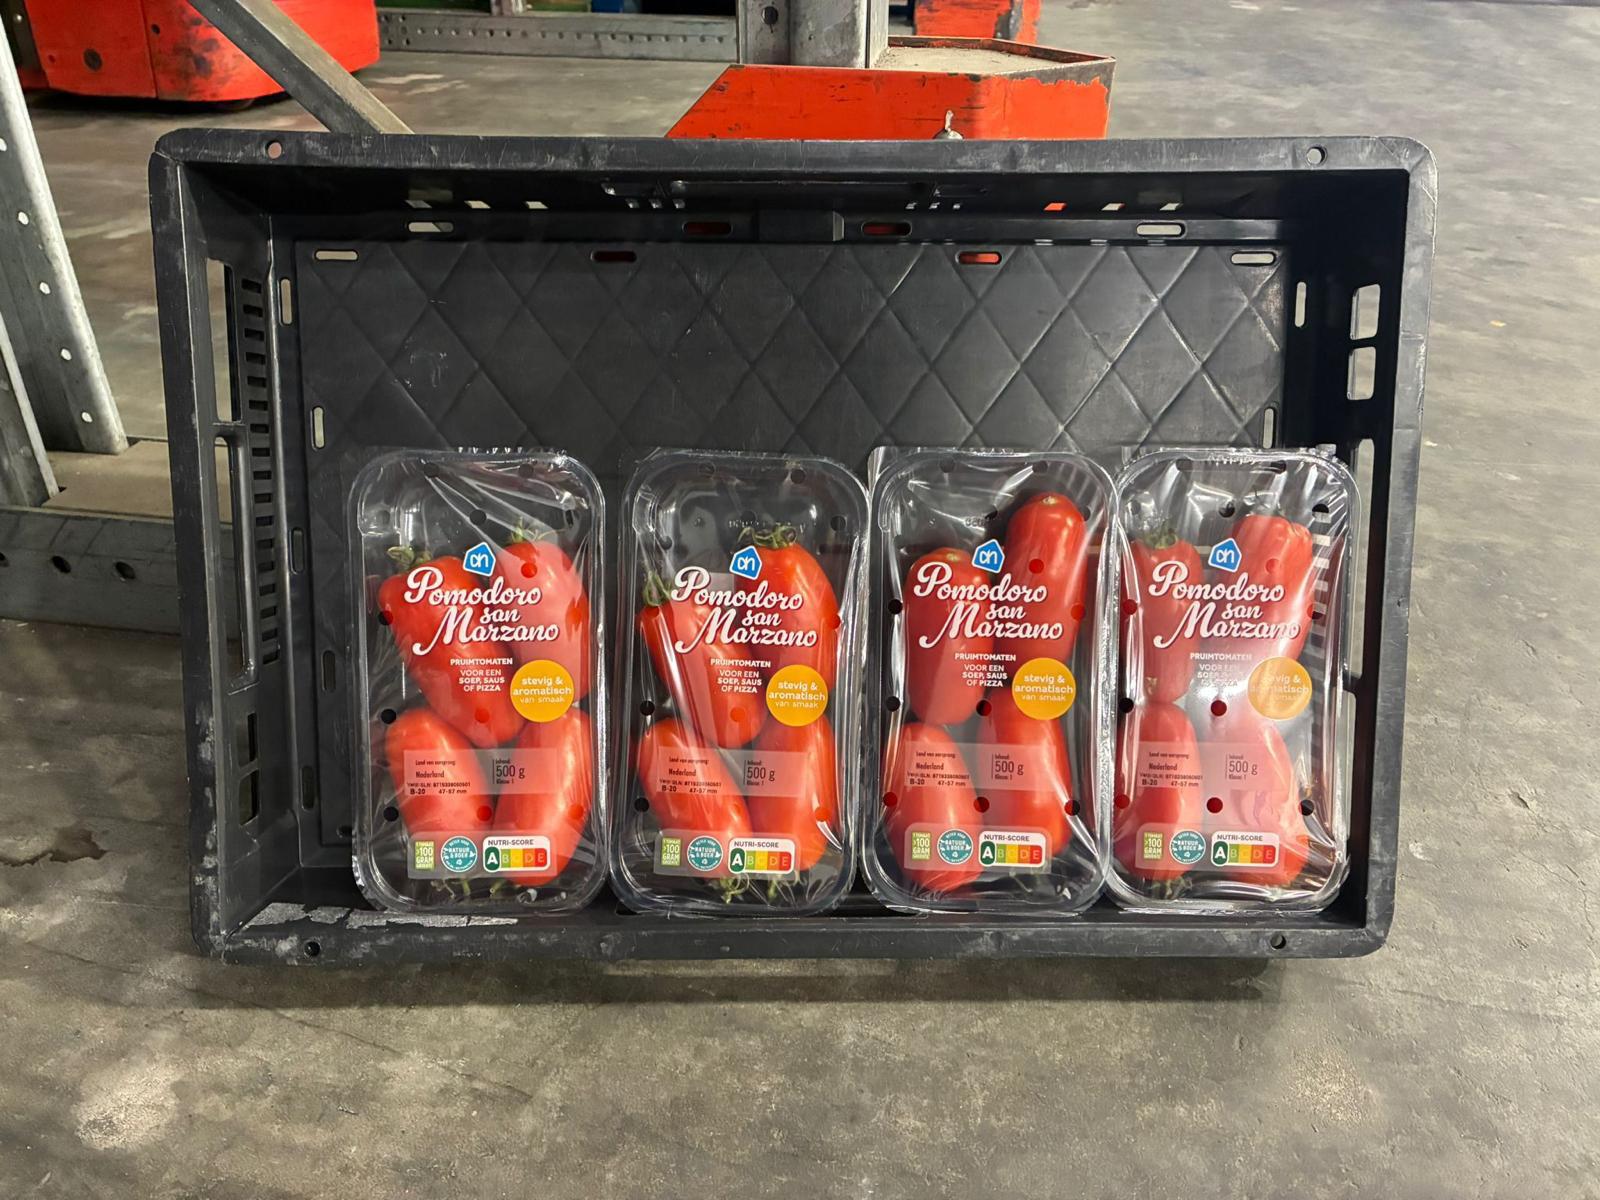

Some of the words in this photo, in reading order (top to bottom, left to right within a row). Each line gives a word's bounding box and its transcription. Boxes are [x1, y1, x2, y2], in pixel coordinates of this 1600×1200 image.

[404, 566, 542, 606] Pomodoro
[671, 566, 803, 610] Pomodoro
[914, 562, 1047, 602] Pomodoro
[1149, 561, 1285, 602] Pomodoro
[480, 607, 521, 624] san
[986, 603, 1026, 620] san
[1222, 602, 1263, 619] san
[742, 610, 782, 627] san
[919, 602, 1063, 648] Marzano
[1153, 602, 1300, 648] Marzano
[412, 606, 559, 656] Marzano
[675, 607, 817, 654] Marzano
[450, 658, 513, 666] PRUIMTOMATEN
[711, 659, 771, 668] PRUIMTOMATEN
[955, 653, 1016, 661] PRUIMTOMATEN
[720, 670, 742, 678] VOOR
[962, 671, 985, 679] SOEP,
[987, 672, 1008, 680] SAUS
[1024, 675, 1054, 684] stevig
[1057, 675, 1065, 683] &
[1293, 675, 1301, 683] &
[522, 677, 552, 686] stevig
[555, 677, 563, 685] &
[718, 677, 740, 685] SOEP,
[741, 678, 762, 686] SAUS
[778, 682, 808, 692] stevig
[734, 686, 758, 694] PIZZA
[1015, 685, 1073, 694] aromatisch
[769, 692, 825, 701] aromatisch
[496, 765, 516, 777] 500
[519, 768, 525, 779] g
[916, 762, 944, 770] Nederland
[995, 761, 1014, 773] 500
[1017, 764, 1024, 776] g
[1229, 761, 1249, 773] 500
[1251, 764, 1258, 776] g
[747, 767, 766, 779] 500
[769, 770, 775, 782] g
[487, 852, 498, 864] A
[982, 846, 993, 859] A
[1215, 847, 1226, 859] A
[732, 853, 743, 866] A
